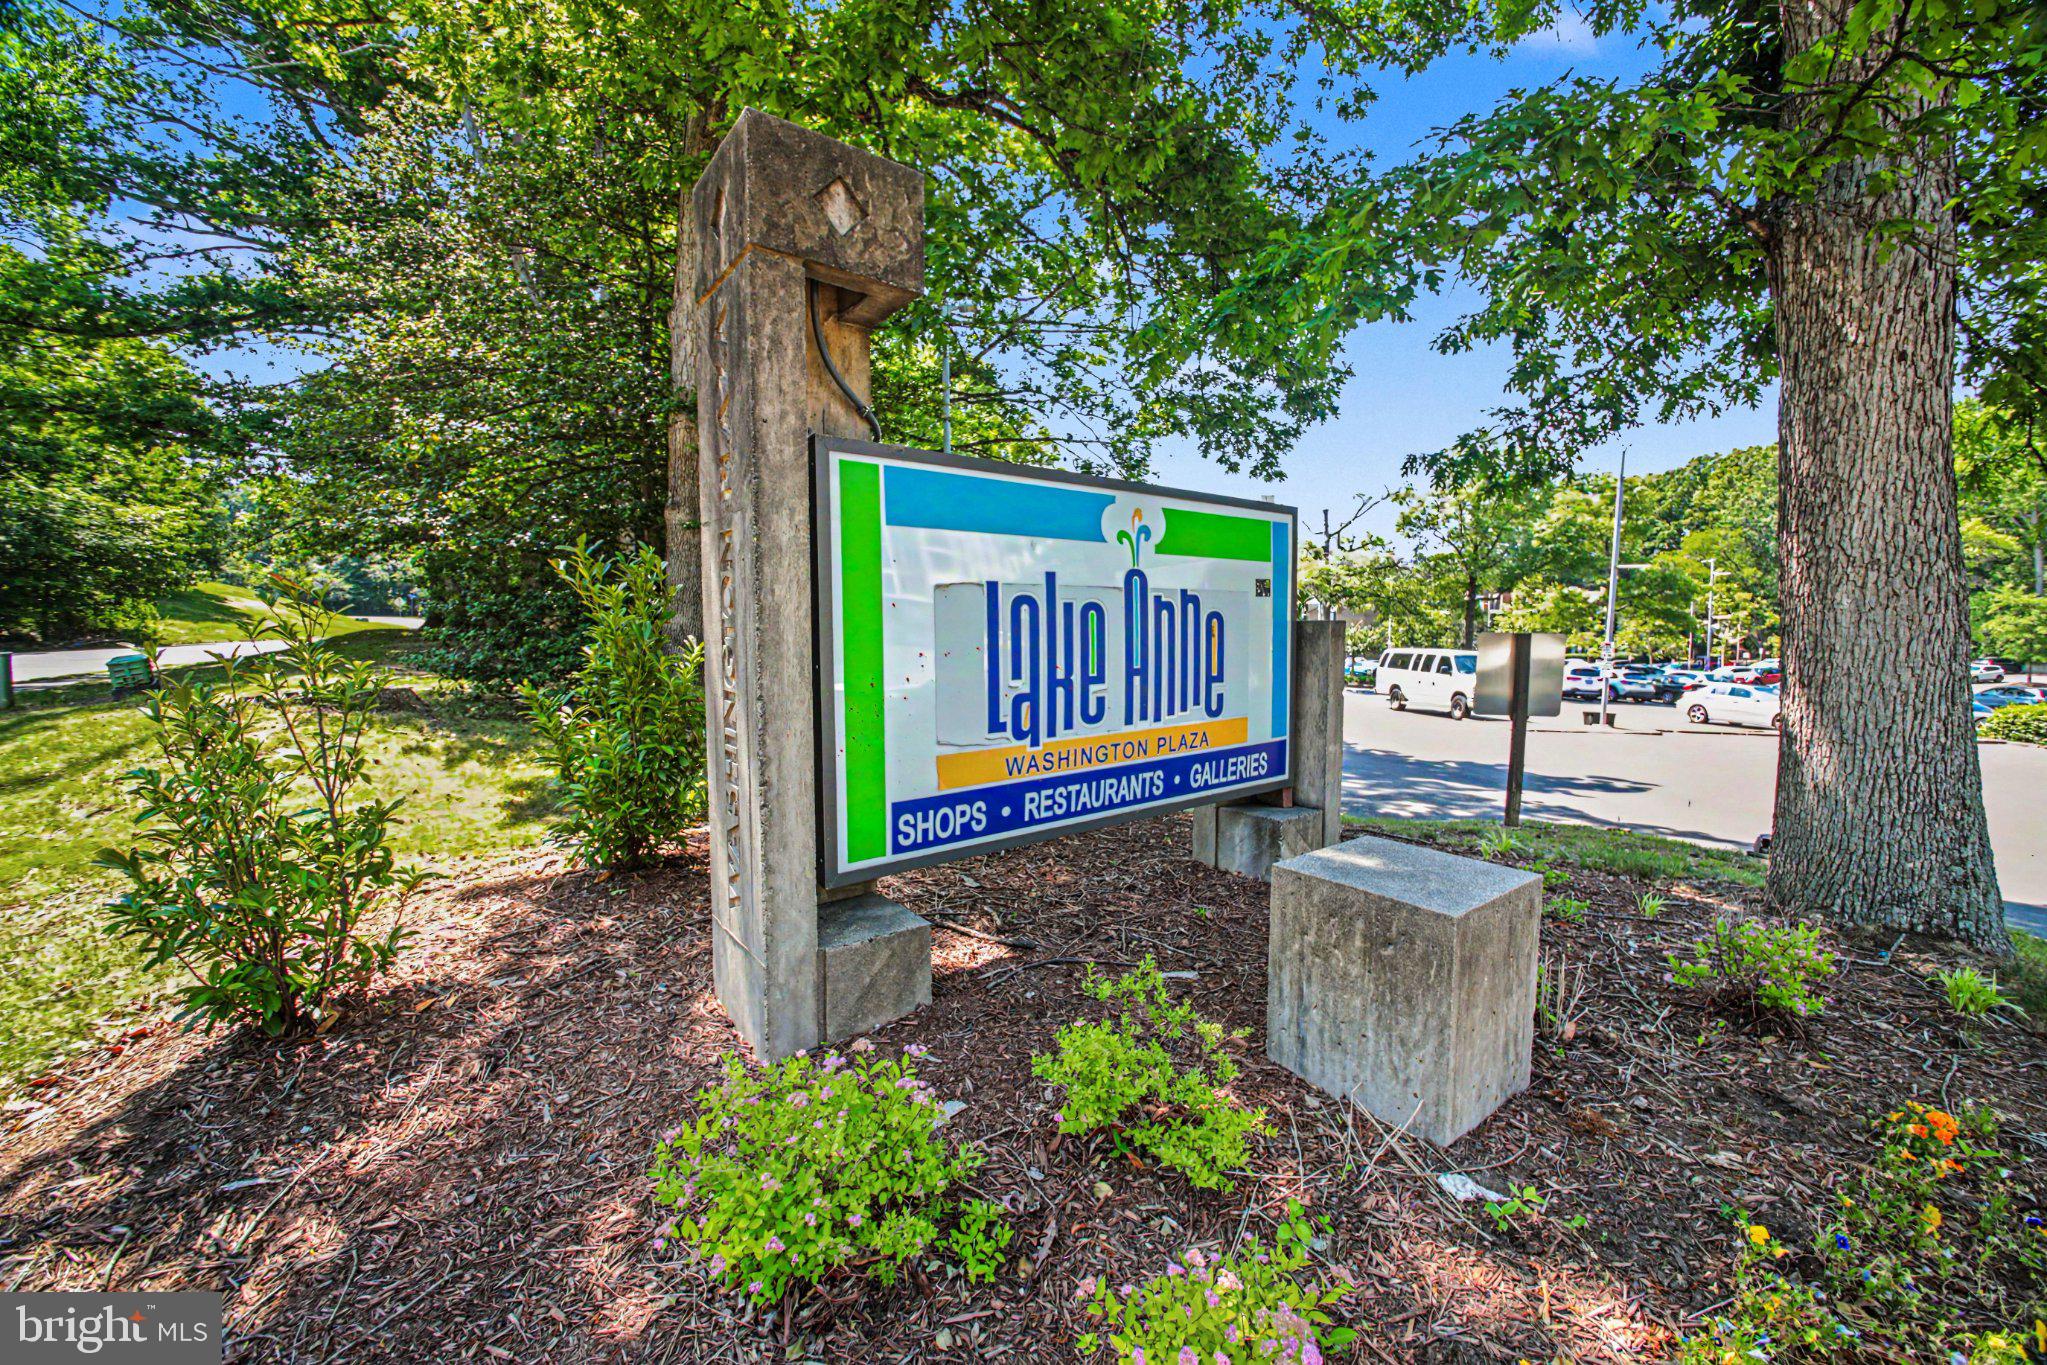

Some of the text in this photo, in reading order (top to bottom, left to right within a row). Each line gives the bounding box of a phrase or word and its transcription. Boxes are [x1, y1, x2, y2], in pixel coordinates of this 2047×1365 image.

[986, 568, 1225, 748] Lake Anne
[898, 752, 1268, 846] SHOPS RESTAURANTS GALLERIES
[1005, 730, 1210, 777] WASHINGTON PLAZA
